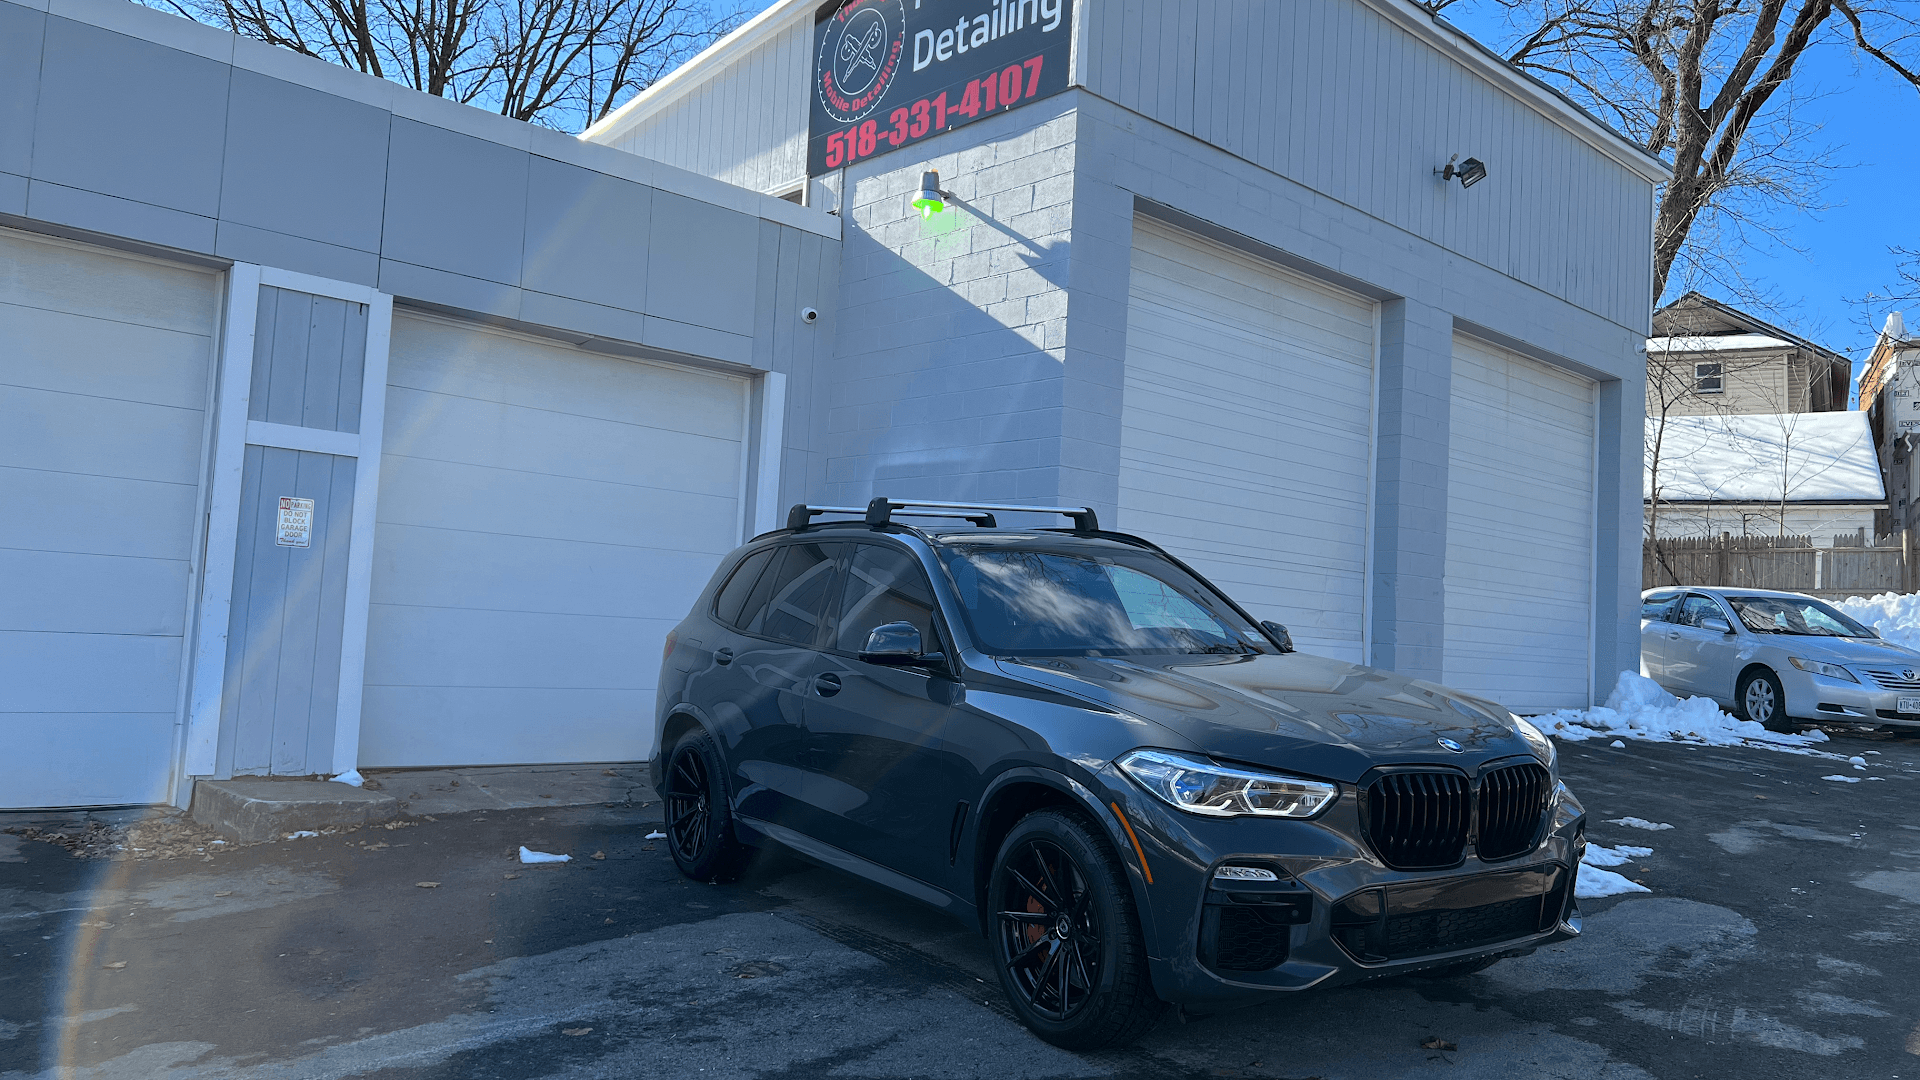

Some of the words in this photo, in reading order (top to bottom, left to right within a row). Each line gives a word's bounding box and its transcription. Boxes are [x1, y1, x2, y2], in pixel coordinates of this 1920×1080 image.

[913, 0, 1062, 72] Detailing
[823, 70, 850, 112] Mobile
[851, 40, 902, 112] Detailing
[825, 55, 1044, 168] 518-331-4107
[280, 499, 290, 509] NO
